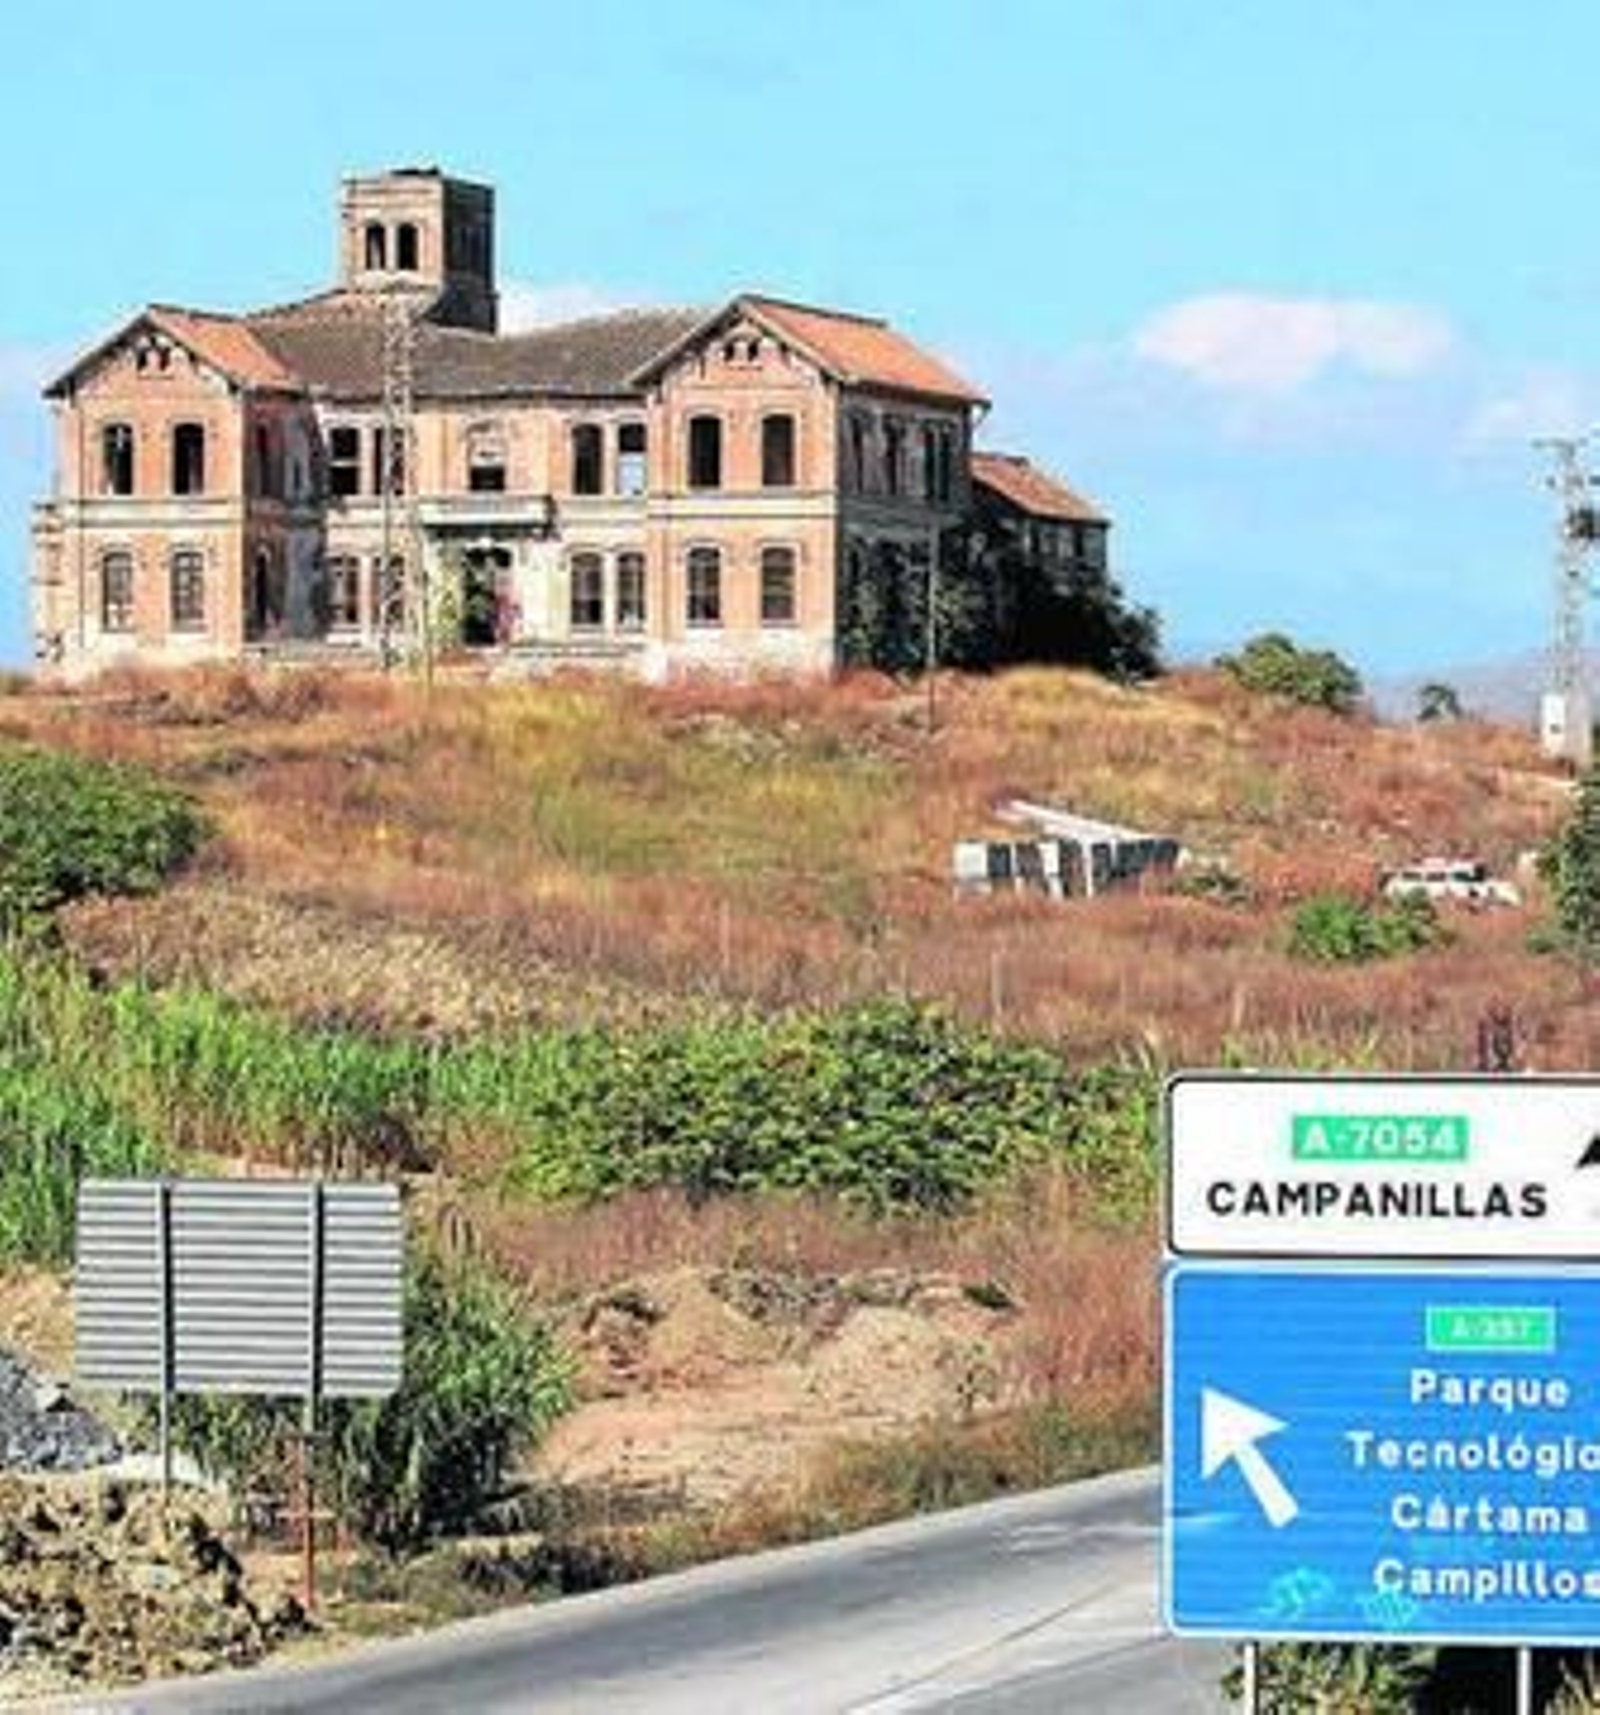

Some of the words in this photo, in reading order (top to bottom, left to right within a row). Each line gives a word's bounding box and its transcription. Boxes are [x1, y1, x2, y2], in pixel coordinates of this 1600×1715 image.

[1301, 1119, 1460, 1155] A-7054
[1207, 1181, 1548, 1218] CAMPANILLAS
[1410, 1368, 1570, 1411] Parque
[1391, 1493, 1589, 1530] Cártama
